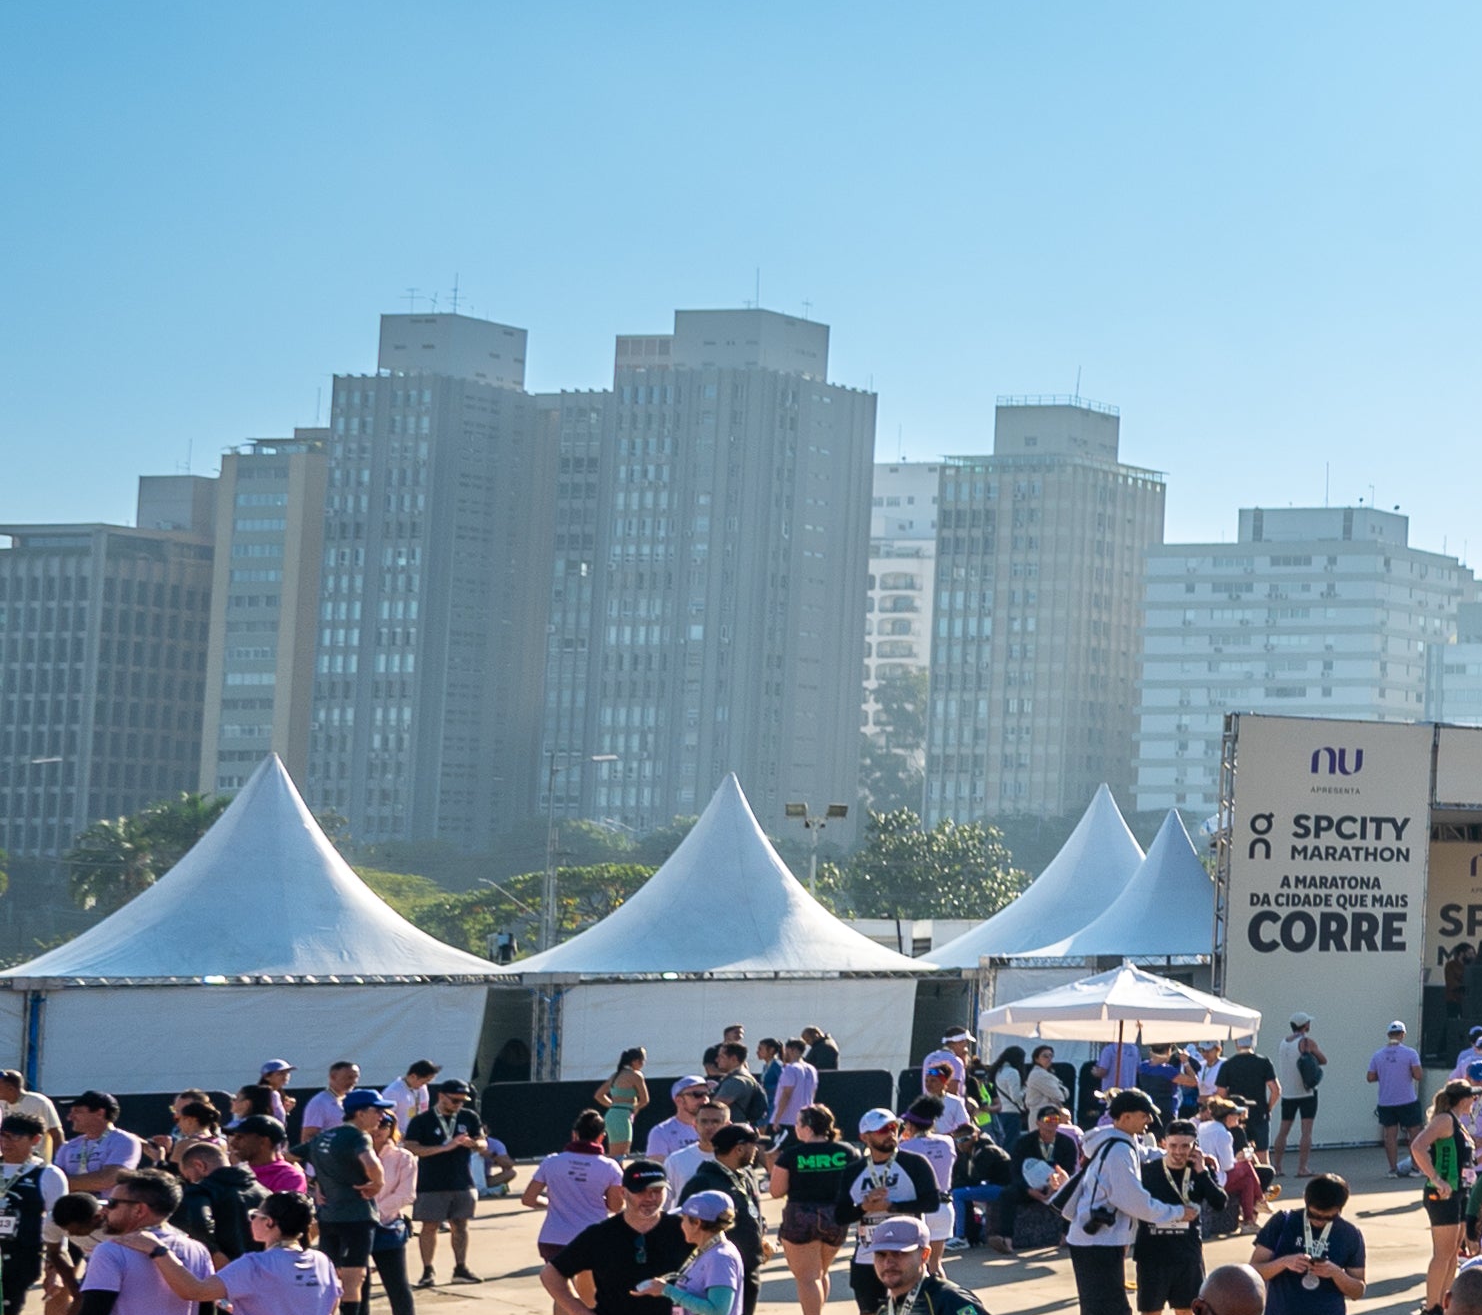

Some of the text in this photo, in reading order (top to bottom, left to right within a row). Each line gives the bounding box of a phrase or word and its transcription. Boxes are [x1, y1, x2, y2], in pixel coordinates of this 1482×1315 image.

[1310, 786, 1362, 795] APRESENTA
[1290, 814, 1411, 843] SPCITY
[1289, 844, 1411, 863] MARATHON
[1280, 875, 1382, 891] A MARATONA
[1249, 892, 1409, 910] DA CIDADE QUE MAIS
[1247, 910, 1408, 954] CORRE
[796, 1153, 847, 1171] MRC
